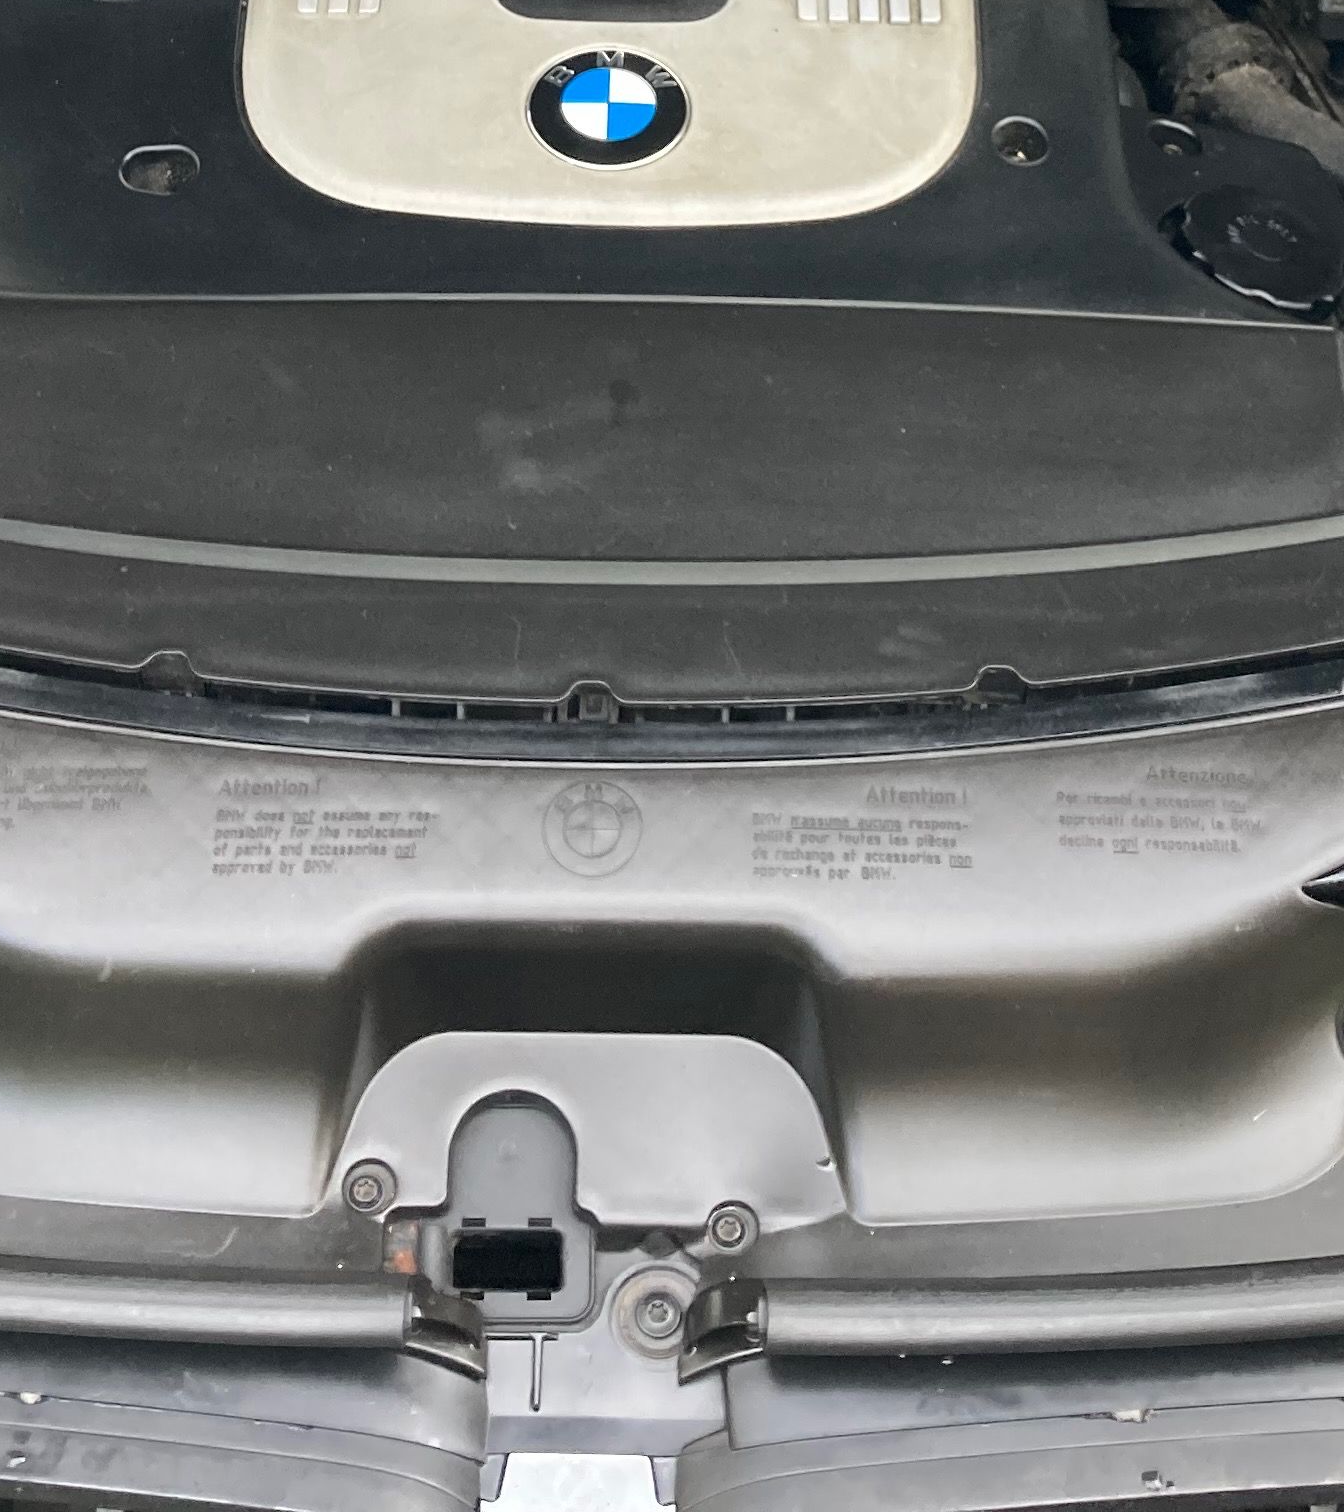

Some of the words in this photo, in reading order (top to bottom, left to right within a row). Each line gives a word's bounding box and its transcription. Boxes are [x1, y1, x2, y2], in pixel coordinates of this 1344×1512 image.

[543, 49, 679, 89] BMW
[1146, 766, 1248, 786] Attenzione
[218, 778, 309, 796] Attention
[866, 785, 956, 804] Attention
